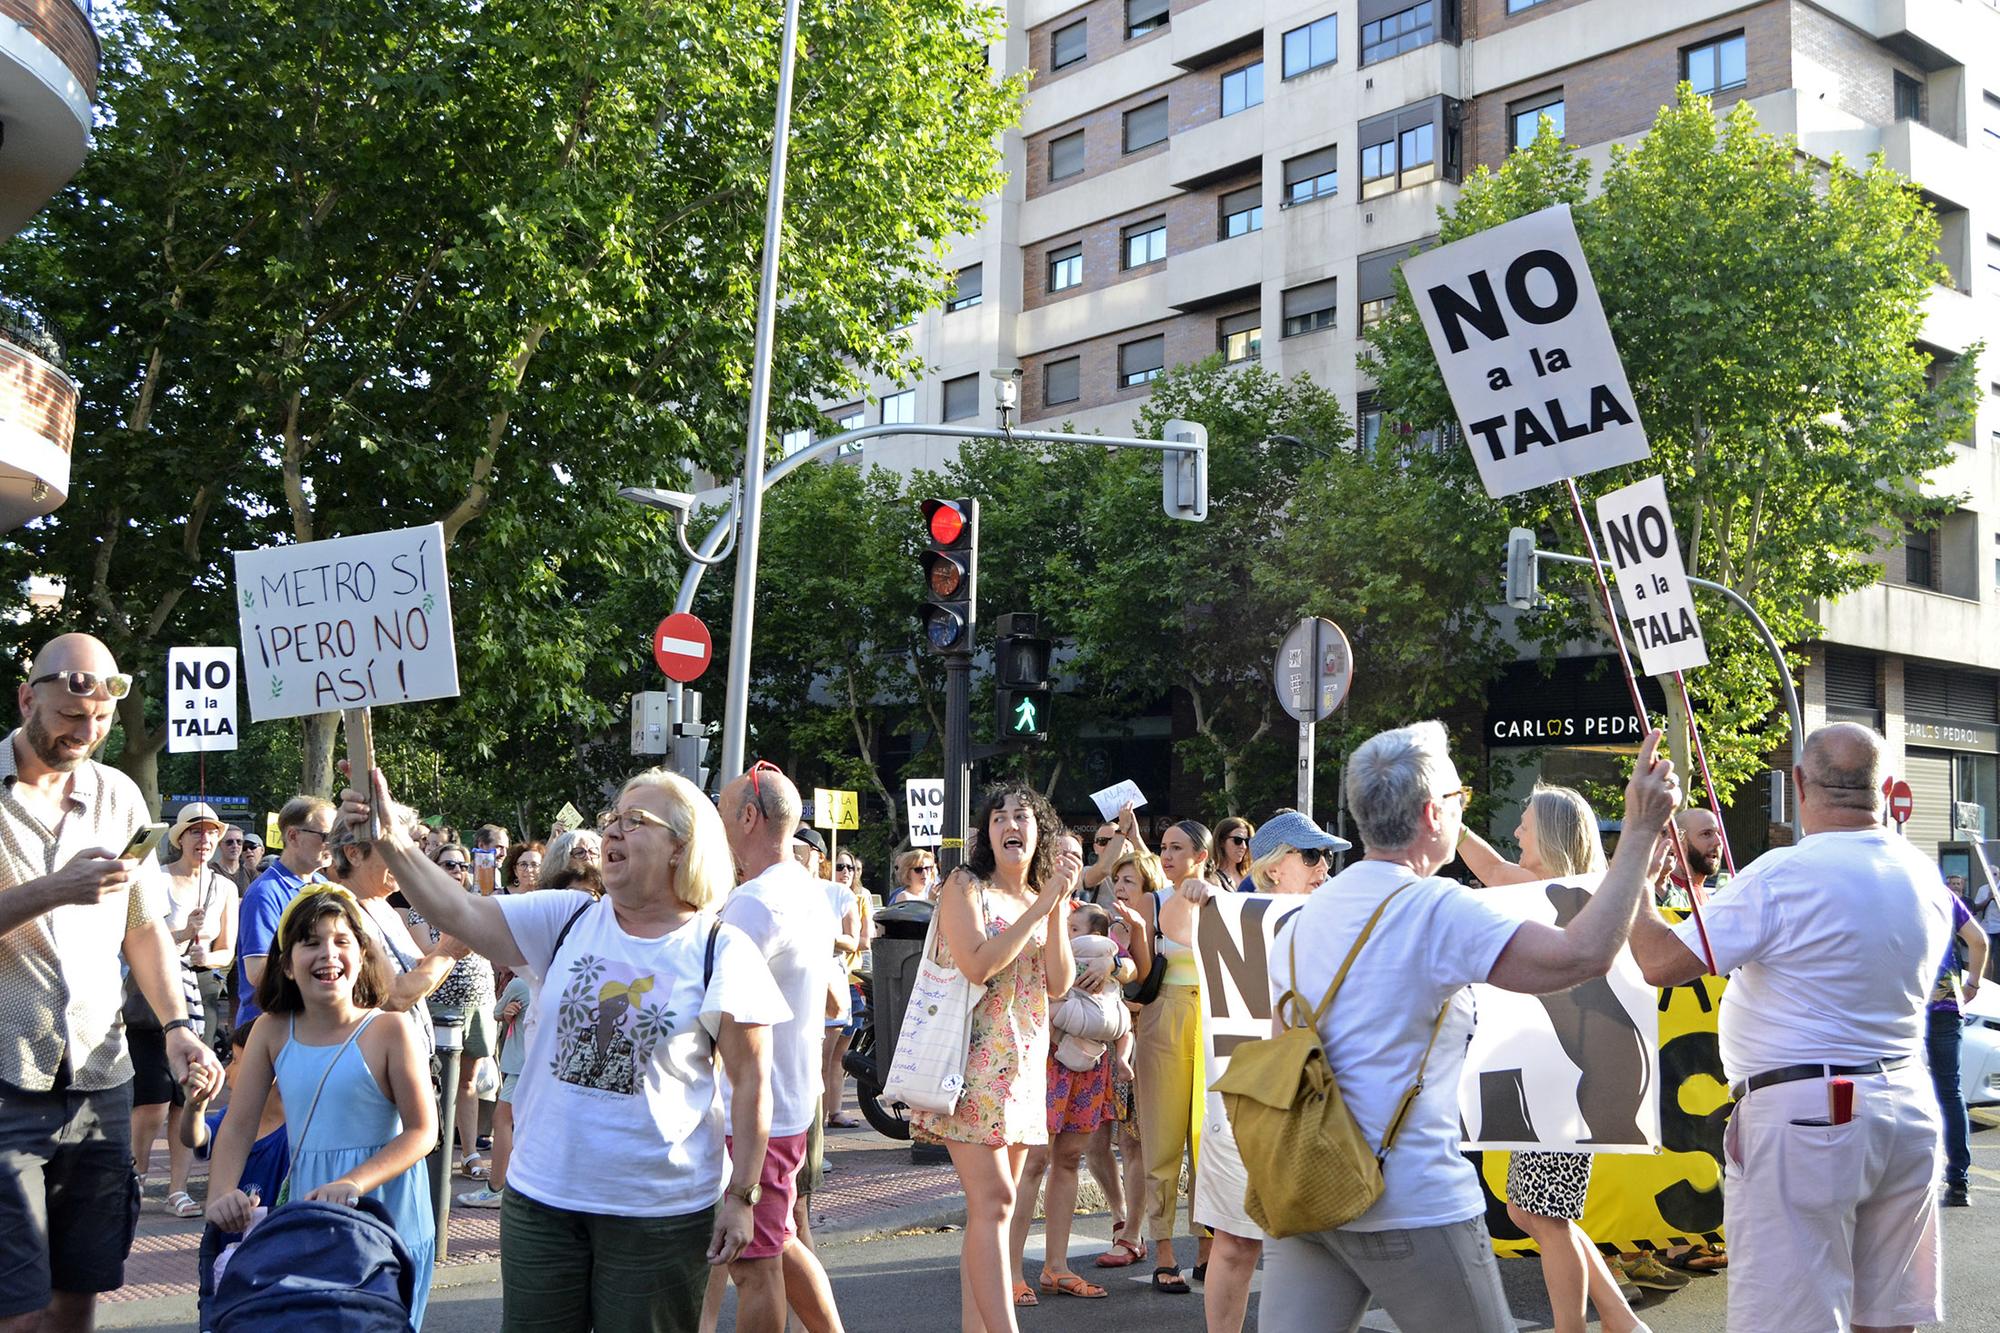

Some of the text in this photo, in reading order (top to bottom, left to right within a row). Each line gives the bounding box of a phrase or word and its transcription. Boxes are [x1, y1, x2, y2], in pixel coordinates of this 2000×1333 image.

[1428, 249, 1578, 355] NO
[1486, 347, 1572, 391] a la
[1470, 385, 1634, 462] TALA
[1606, 505, 1668, 570] NO
[261, 539, 428, 609] METRO SÍ
[1635, 573, 1670, 600] a la
[254, 606, 430, 669] ¡PERO NO
[1632, 607, 1699, 650] TALA
[175, 660, 231, 690] NO
[185, 697, 218, 710] a la
[172, 717, 234, 737] TALA
[1943, 727, 1980, 744] PEDROL
[910, 788, 944, 807] NO
[929, 810, 938, 818] la
[1198, 896, 1304, 1019] N
